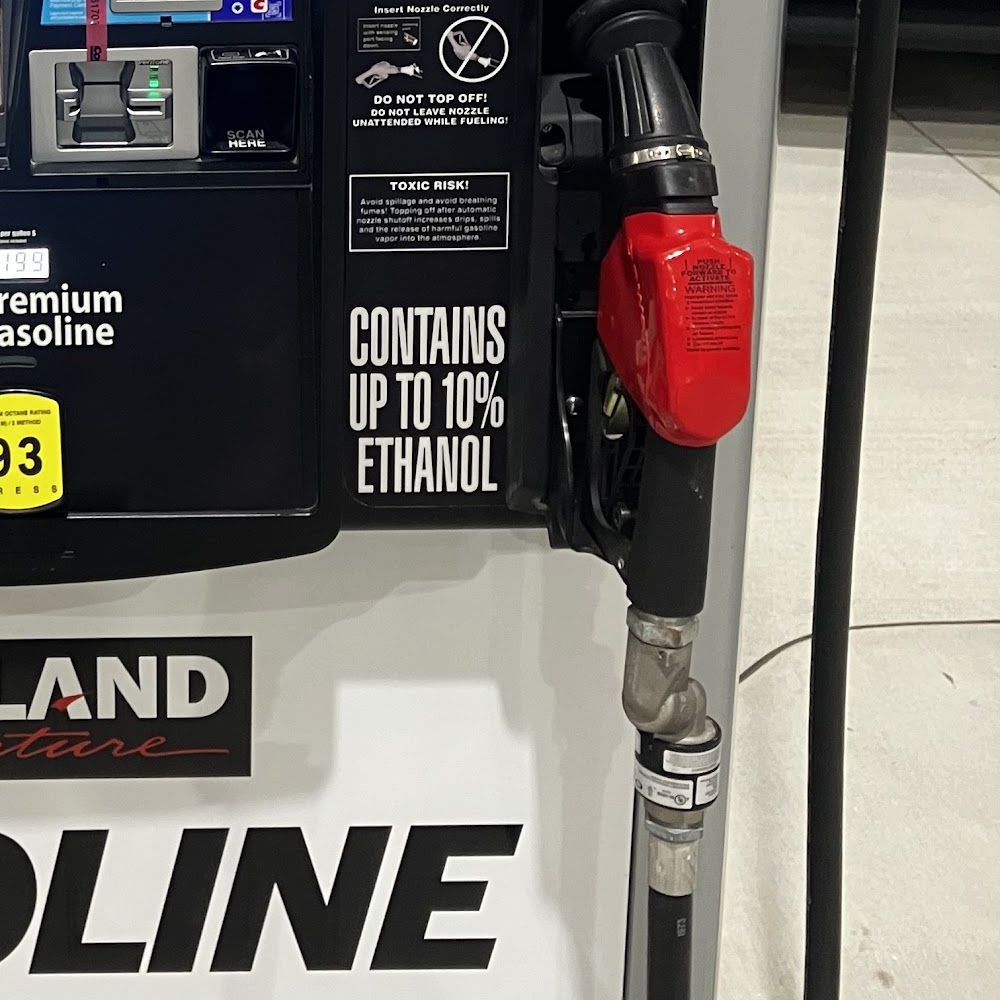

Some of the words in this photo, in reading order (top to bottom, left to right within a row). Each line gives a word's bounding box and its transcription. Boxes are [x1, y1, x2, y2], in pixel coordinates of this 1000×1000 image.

[443, 4, 489, 13] Correctly
[374, 95, 392, 104] DO
[397, 94, 424, 104] NOT
[428, 94, 454, 103] TOP
[458, 94, 487, 103] OFF!
[413, 108, 445, 116] LEAVE
[449, 107, 489, 115] NOZZLE
[353, 118, 421, 127] UNATTENDED
[460, 117, 508, 125] FUELING!
[227, 129, 265, 140] SCAN
[228, 139, 267, 148] HERE
[390, 181, 429, 190] TOXIC
[434, 181, 468, 190] RISK!
[390, 207, 422, 215] Topping
[684, 284, 736, 294] WARNING
[350, 305, 505, 366] CONTAINS
[350, 373, 387, 431] UP
[396, 371, 431, 430] TO
[442, 371, 504, 429] 10%
[358, 435, 497, 493] ETHANOL
